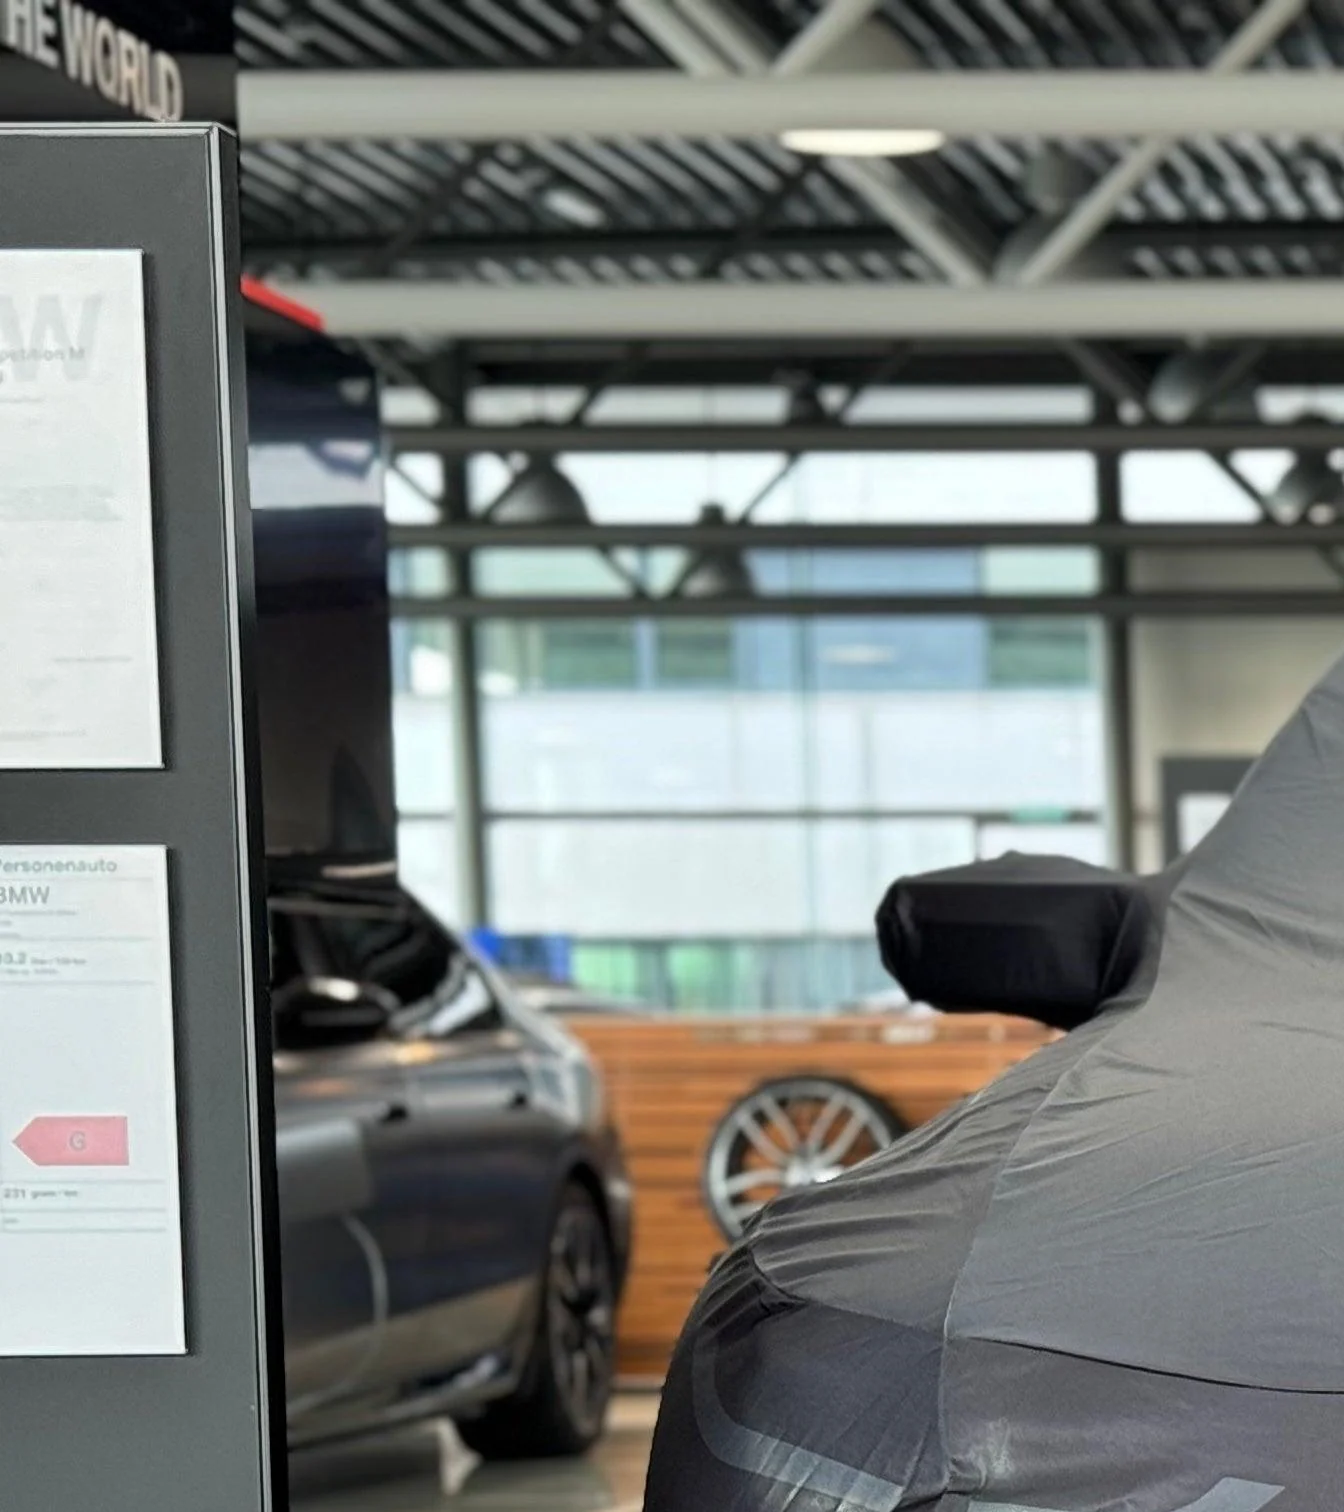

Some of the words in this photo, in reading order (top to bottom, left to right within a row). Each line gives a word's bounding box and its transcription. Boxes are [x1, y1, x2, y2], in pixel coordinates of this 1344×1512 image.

[3, 0, 58, 68] HE
[59, 0, 183, 121] WORLD
[0, 859, 117, 873] ersonenauto
[69, 1131, 86, 1151] G
